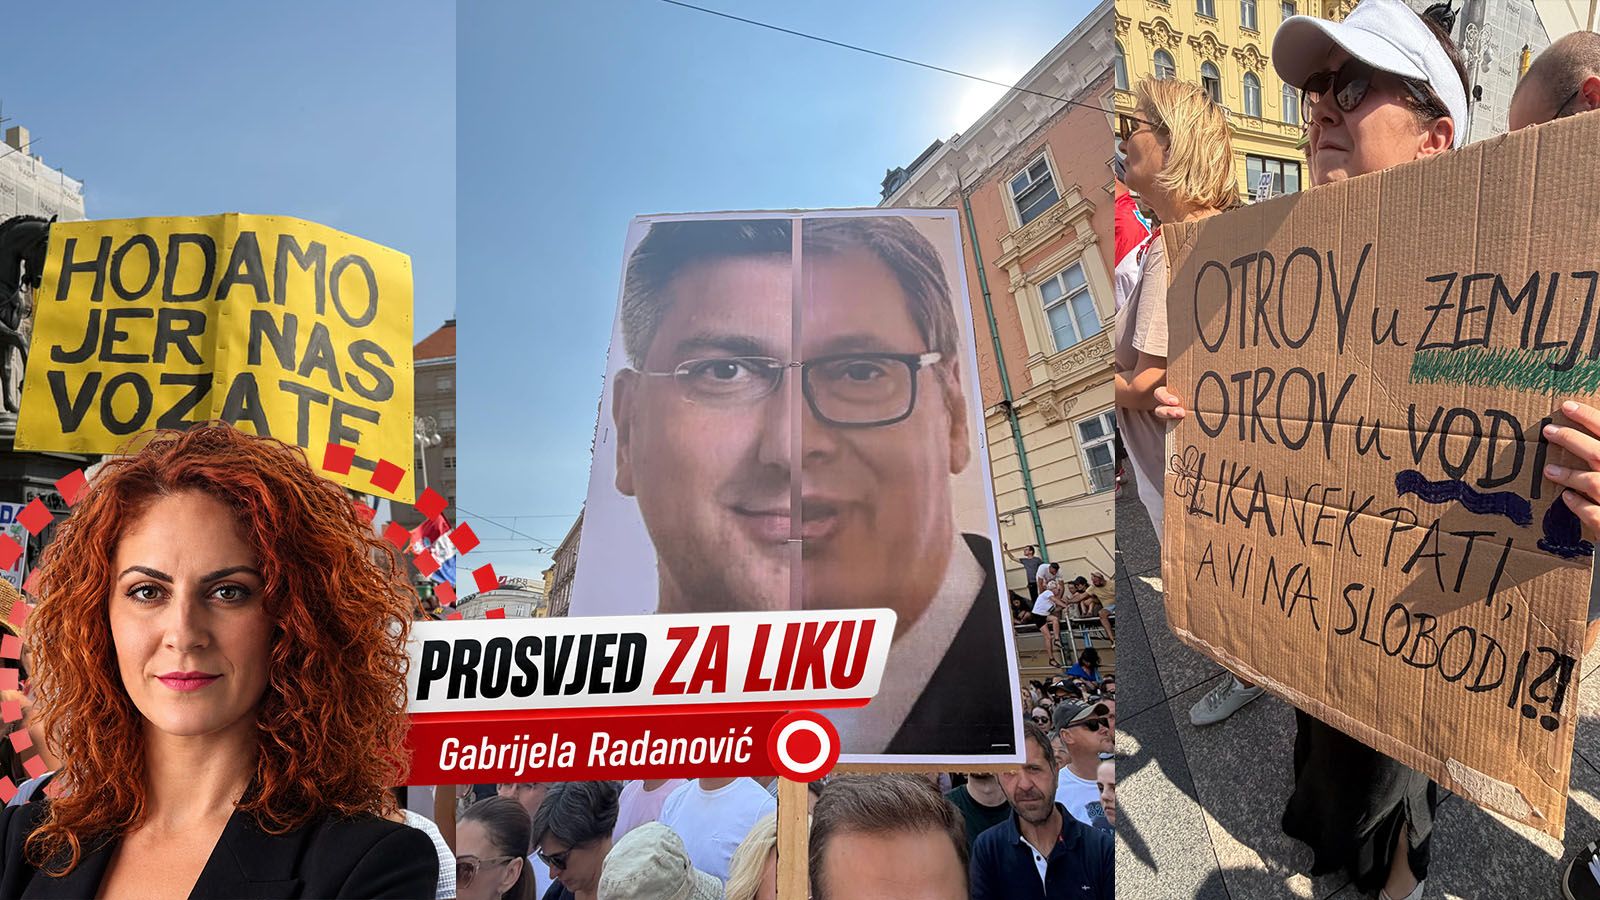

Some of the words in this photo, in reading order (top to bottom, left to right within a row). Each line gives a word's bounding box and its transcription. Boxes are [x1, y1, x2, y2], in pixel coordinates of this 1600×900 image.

[56, 231, 379, 328] HODAMO
[1194, 243, 1372, 354] OTROV
[1371, 307, 1408, 346] u
[50, 308, 207, 365] JER
[247, 310, 395, 401] NAS
[47, 371, 381, 471] VOZATE
[1194, 366, 1357, 460] OTROV
[1355, 415, 1391, 461] u
[1408, 403, 1552, 500] VODI
[1195, 540, 1218, 587] A
[1227, 542, 1253, 598] VI
[1261, 555, 1321, 632] NA
[1379, 506, 1514, 622] PATI,
